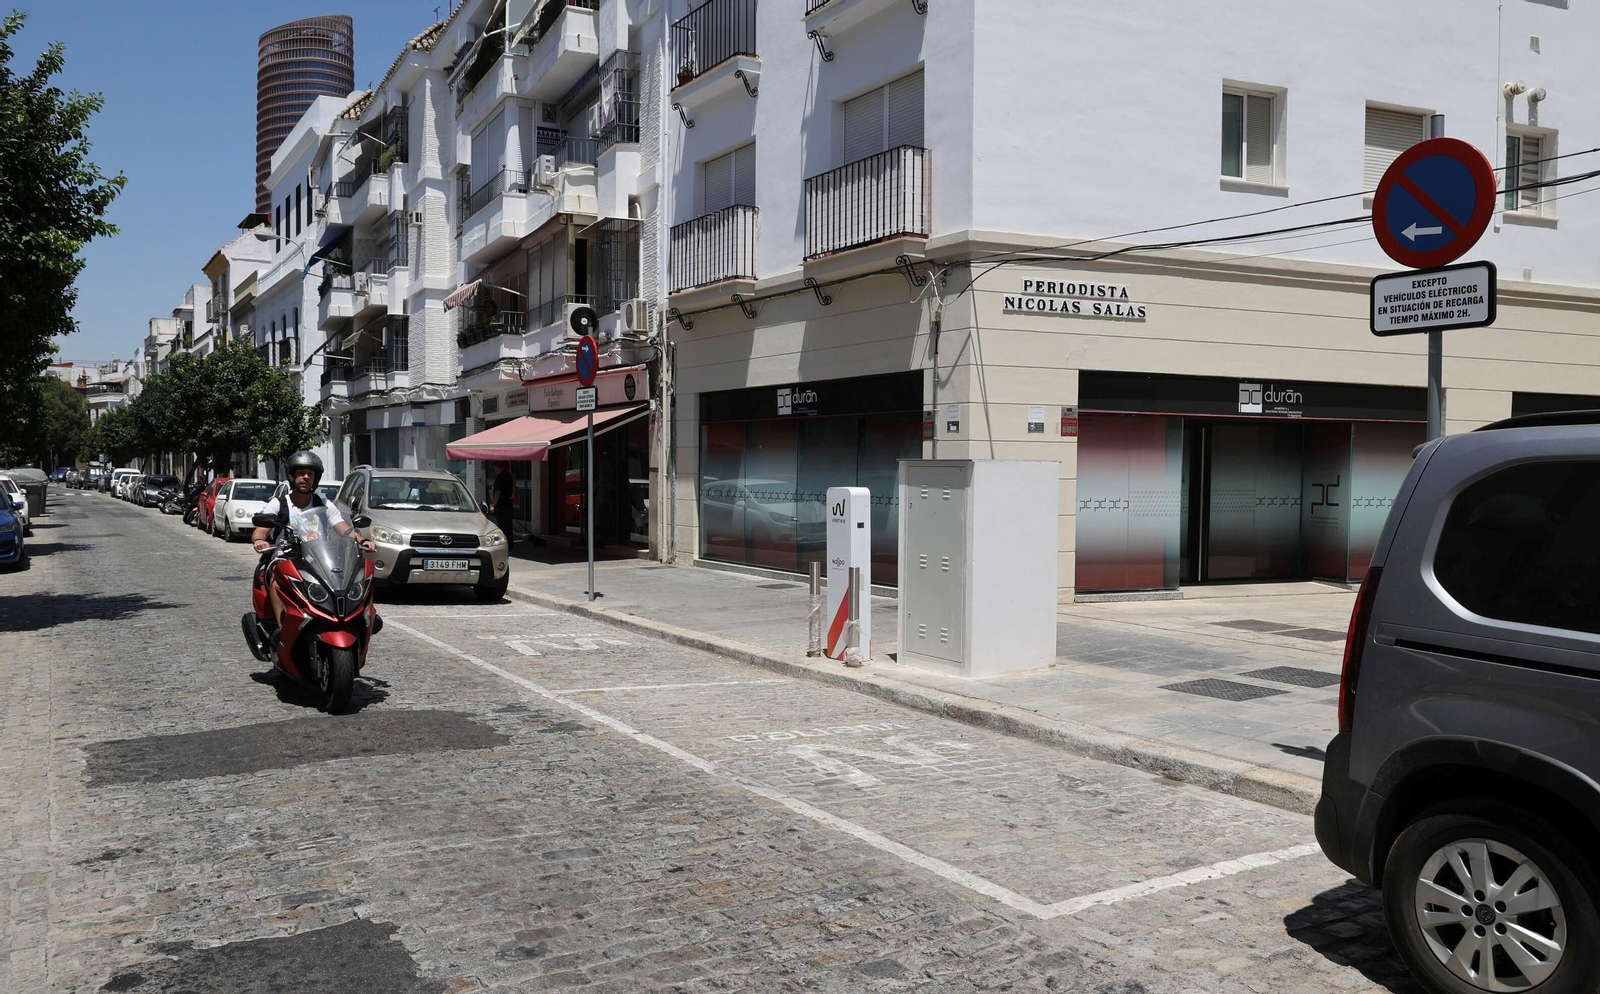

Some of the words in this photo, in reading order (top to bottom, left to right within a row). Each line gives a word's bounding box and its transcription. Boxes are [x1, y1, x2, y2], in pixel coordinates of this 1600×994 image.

[1023, 279, 1129, 298] PERIODISTA
[1412, 277, 1447, 288] EXCEPTO
[1383, 290, 1426, 303] VEHÍCULOS
[1428, 285, 1478, 298] ELÉCTRICOS
[1004, 296, 1081, 314] NICOLAS
[1092, 302, 1147, 318] SALAS
[1378, 306, 1388, 315] EN
[1389, 301, 1431, 314] SITUACIÓN
[1433, 300, 1443, 309] DE
[1446, 296, 1484, 308] RECARGA
[1389, 314, 1419, 325] TIEMPO
[1421, 311, 1456, 322] MÁXIMO
[1457, 309, 1471, 318] 2H.
[430, 561, 450, 569] 3149
[451, 561, 467, 569] FHM
